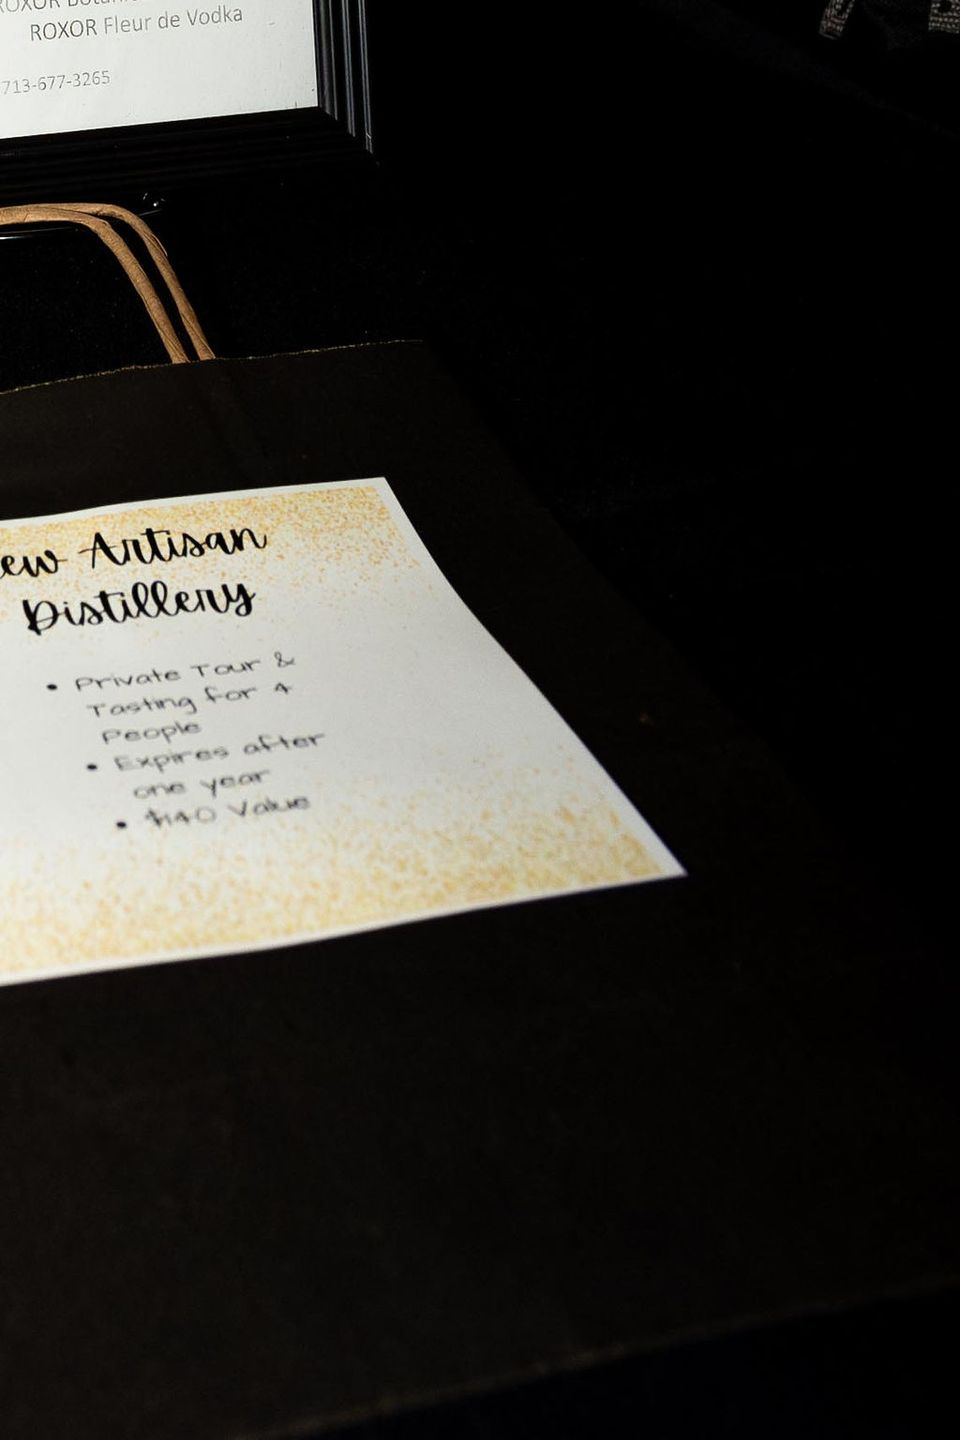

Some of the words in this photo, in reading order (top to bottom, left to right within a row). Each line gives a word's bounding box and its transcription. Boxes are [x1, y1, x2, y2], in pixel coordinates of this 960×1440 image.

[30, 17, 98, 42] ROXOR
[103, 14, 152, 35] Fleur
[157, 10, 181, 30] de
[186, 4, 243, 27] Vodka
[1, 69, 111, 96] 713-677-3265
[77, 527, 268, 569] Artisan
[22, 579, 257, 637] Distillery
[75, 668, 182, 692] Private
[190, 658, 262, 679] Tour
[274, 651, 296, 669] &
[86, 694, 198, 718] Tasting
[203, 686, 257, 705] for
[274, 681, 293, 696] 4
[101, 720, 203, 745] People
[113, 746, 230, 774] Expires
[243, 733, 326, 757] after
[133, 780, 187, 800] one
[200, 768, 271, 799] year
[144, 805, 217, 829] $140
[227, 794, 312, 819] Value
